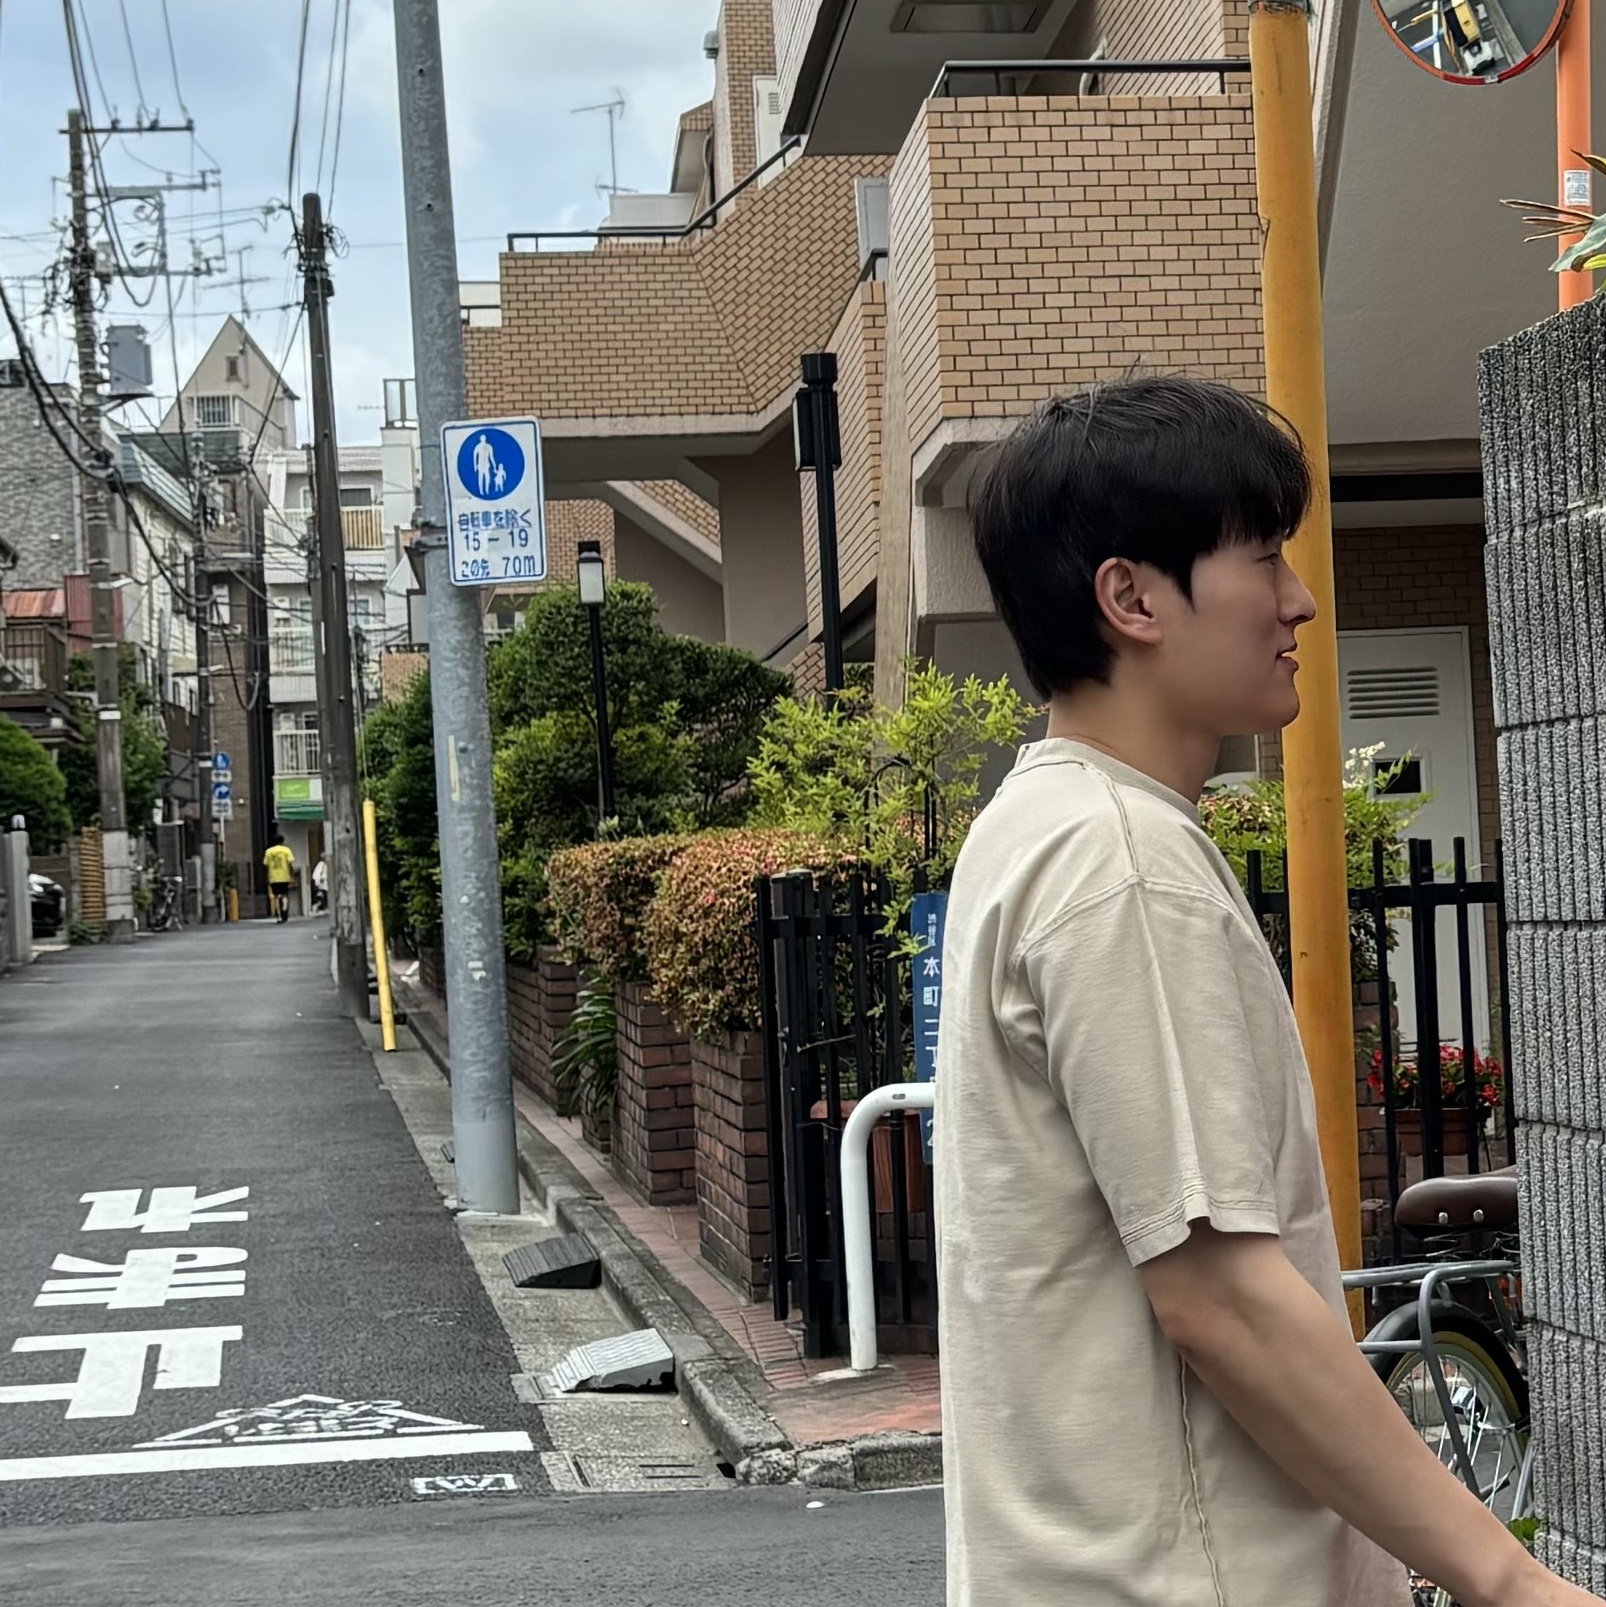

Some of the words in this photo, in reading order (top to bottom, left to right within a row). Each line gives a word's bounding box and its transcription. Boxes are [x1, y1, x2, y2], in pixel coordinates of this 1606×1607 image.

[458, 508, 532, 531] 自転車を除く
[461, 558, 491, 578] この先
[501, 555, 536, 576] 70m
[923, 956, 940, 1082] 本町二丁
[0, 1186, 250, 1419] 止まれ
